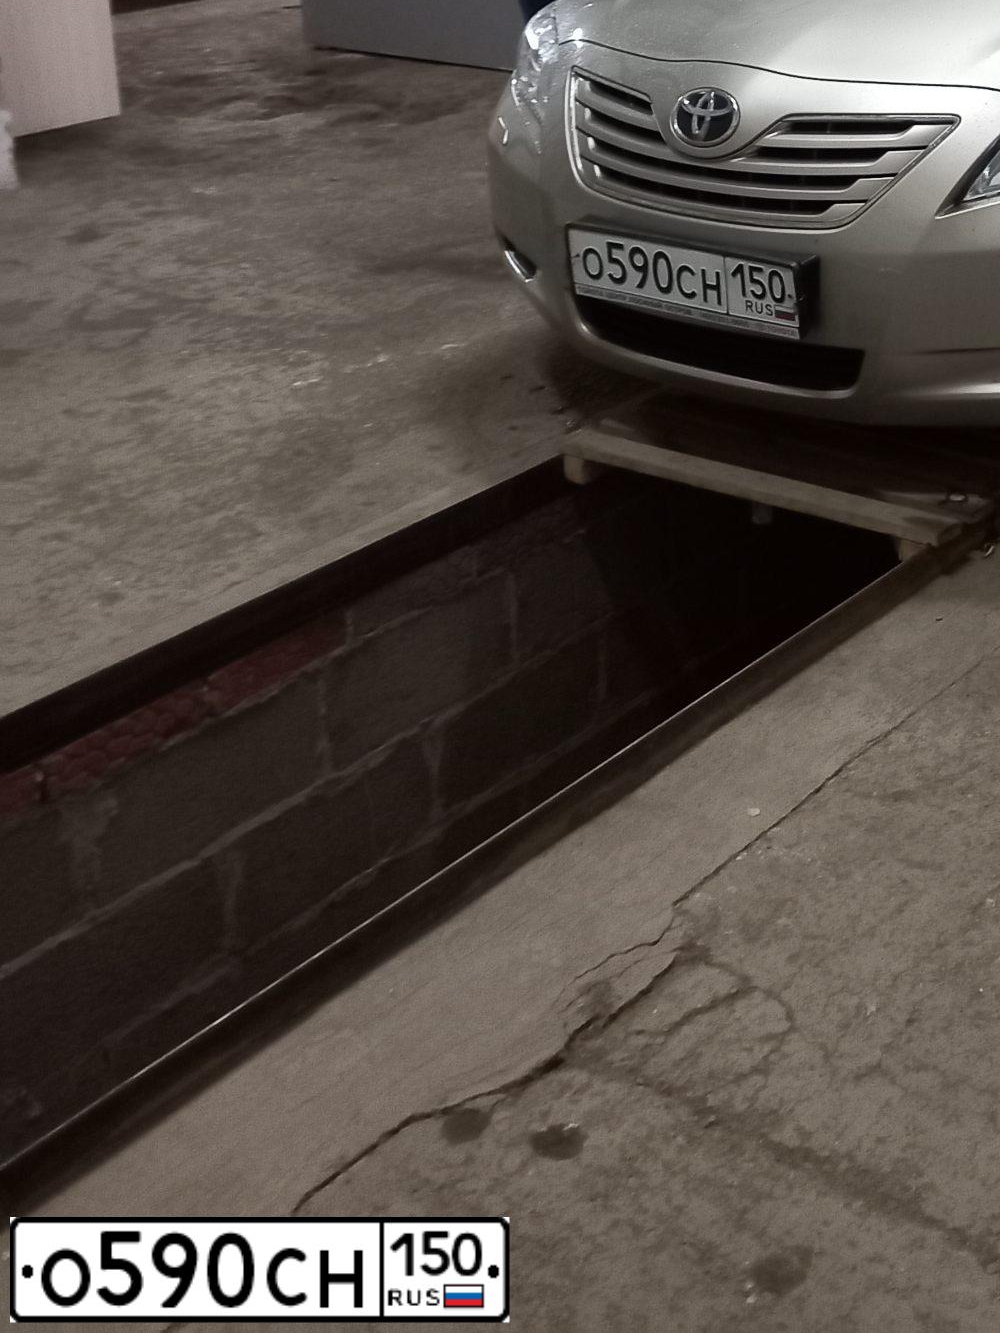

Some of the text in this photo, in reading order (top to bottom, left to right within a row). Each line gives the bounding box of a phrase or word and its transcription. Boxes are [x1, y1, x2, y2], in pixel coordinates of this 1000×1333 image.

[581, 241, 722, 306] О590СН
[730, 263, 786, 304] 150
[745, 300, 774, 317] RUS
